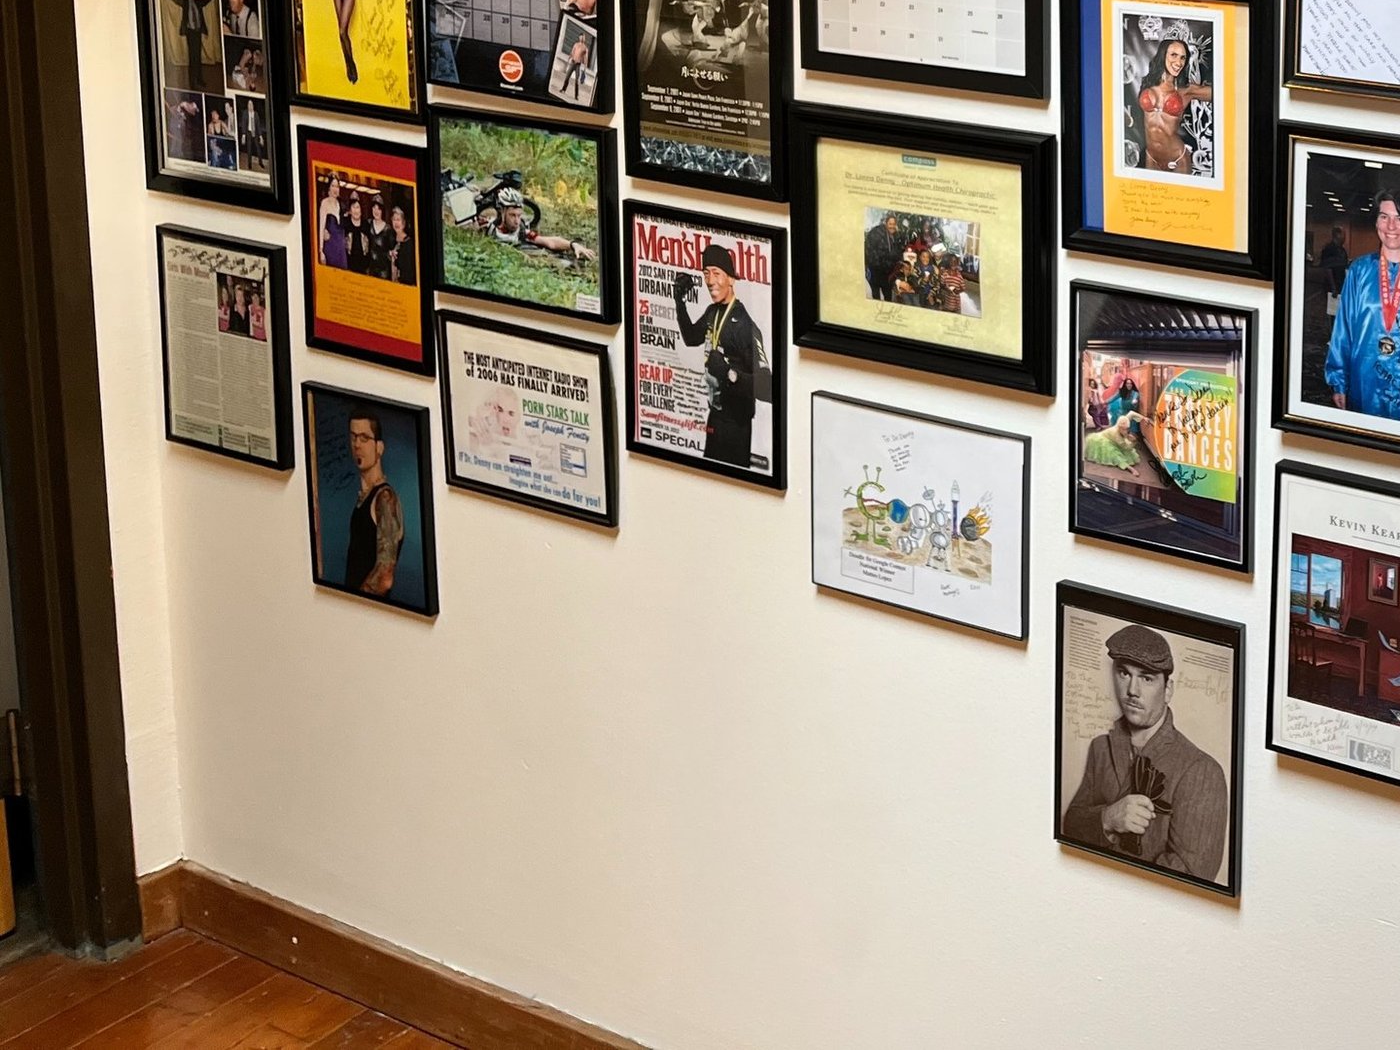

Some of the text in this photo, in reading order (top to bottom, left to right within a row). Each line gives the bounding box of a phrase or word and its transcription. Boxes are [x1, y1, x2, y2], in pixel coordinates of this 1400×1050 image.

[637, 222, 694, 270] Men's
[639, 264, 666, 281] 2012 SAN
[639, 300, 649, 315] 25
[640, 333, 676, 350] BRAIN
[464, 351, 588, 390] THE MOST ANTICIPATED INTERNET RADIO SHOW
[639, 364, 673, 383] GEAR UP
[466, 365, 589, 403] of 2006 HAS FINALLY ARRIVED!
[640, 381, 672, 398] FOR EVERY
[523, 399, 589, 426] PORN STARS TALK
[640, 393, 676, 413] CHALLENGE
[655, 431, 704, 452] SPECIAL
[1164, 428, 1232, 471] DANCES
[562, 487, 571, 500] do
[573, 489, 583, 503] for
[1330, 515, 1366, 535] KEVIN
